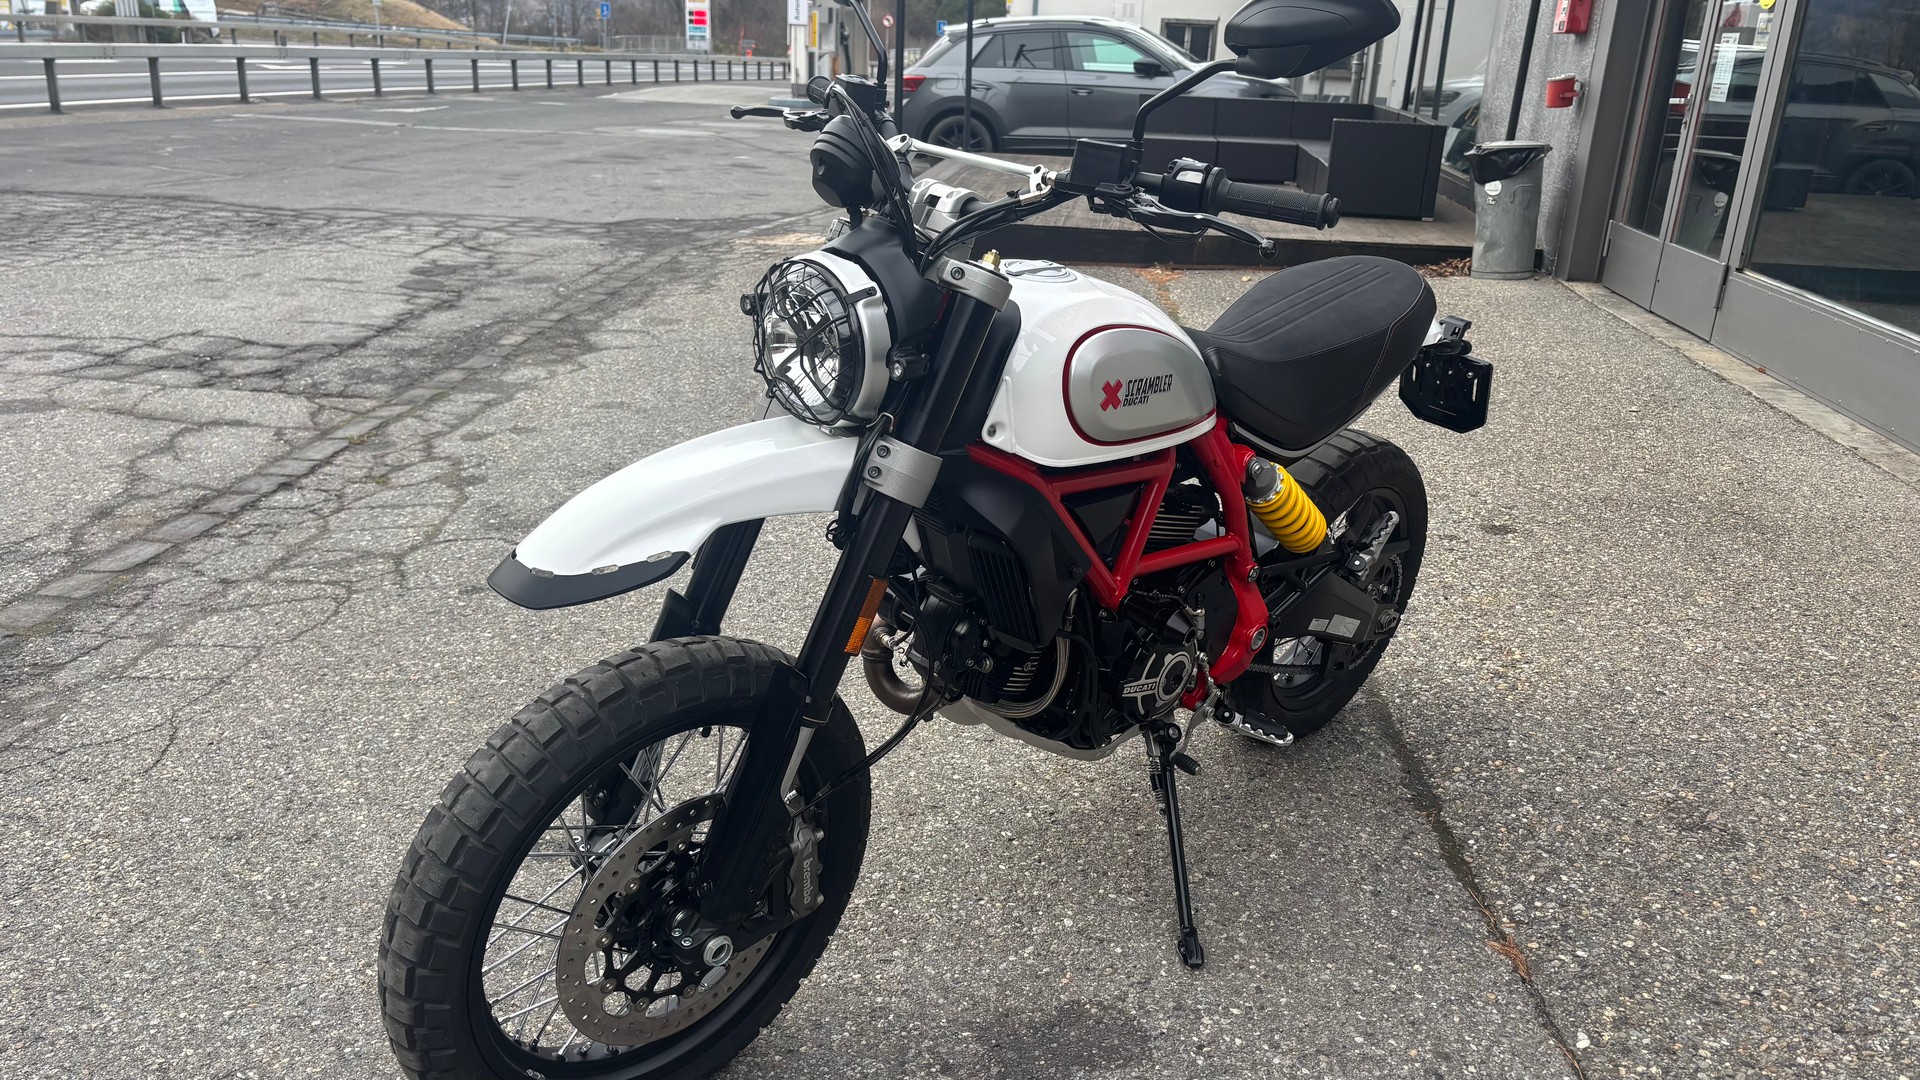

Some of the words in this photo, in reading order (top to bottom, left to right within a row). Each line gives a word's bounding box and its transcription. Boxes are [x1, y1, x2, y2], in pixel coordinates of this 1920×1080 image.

[1125, 374, 1173, 397] SCRAMBLER
[1123, 396, 1149, 407] DUCATI
[1123, 683, 1155, 694] DUCATI
[803, 857, 814, 904] brembo
